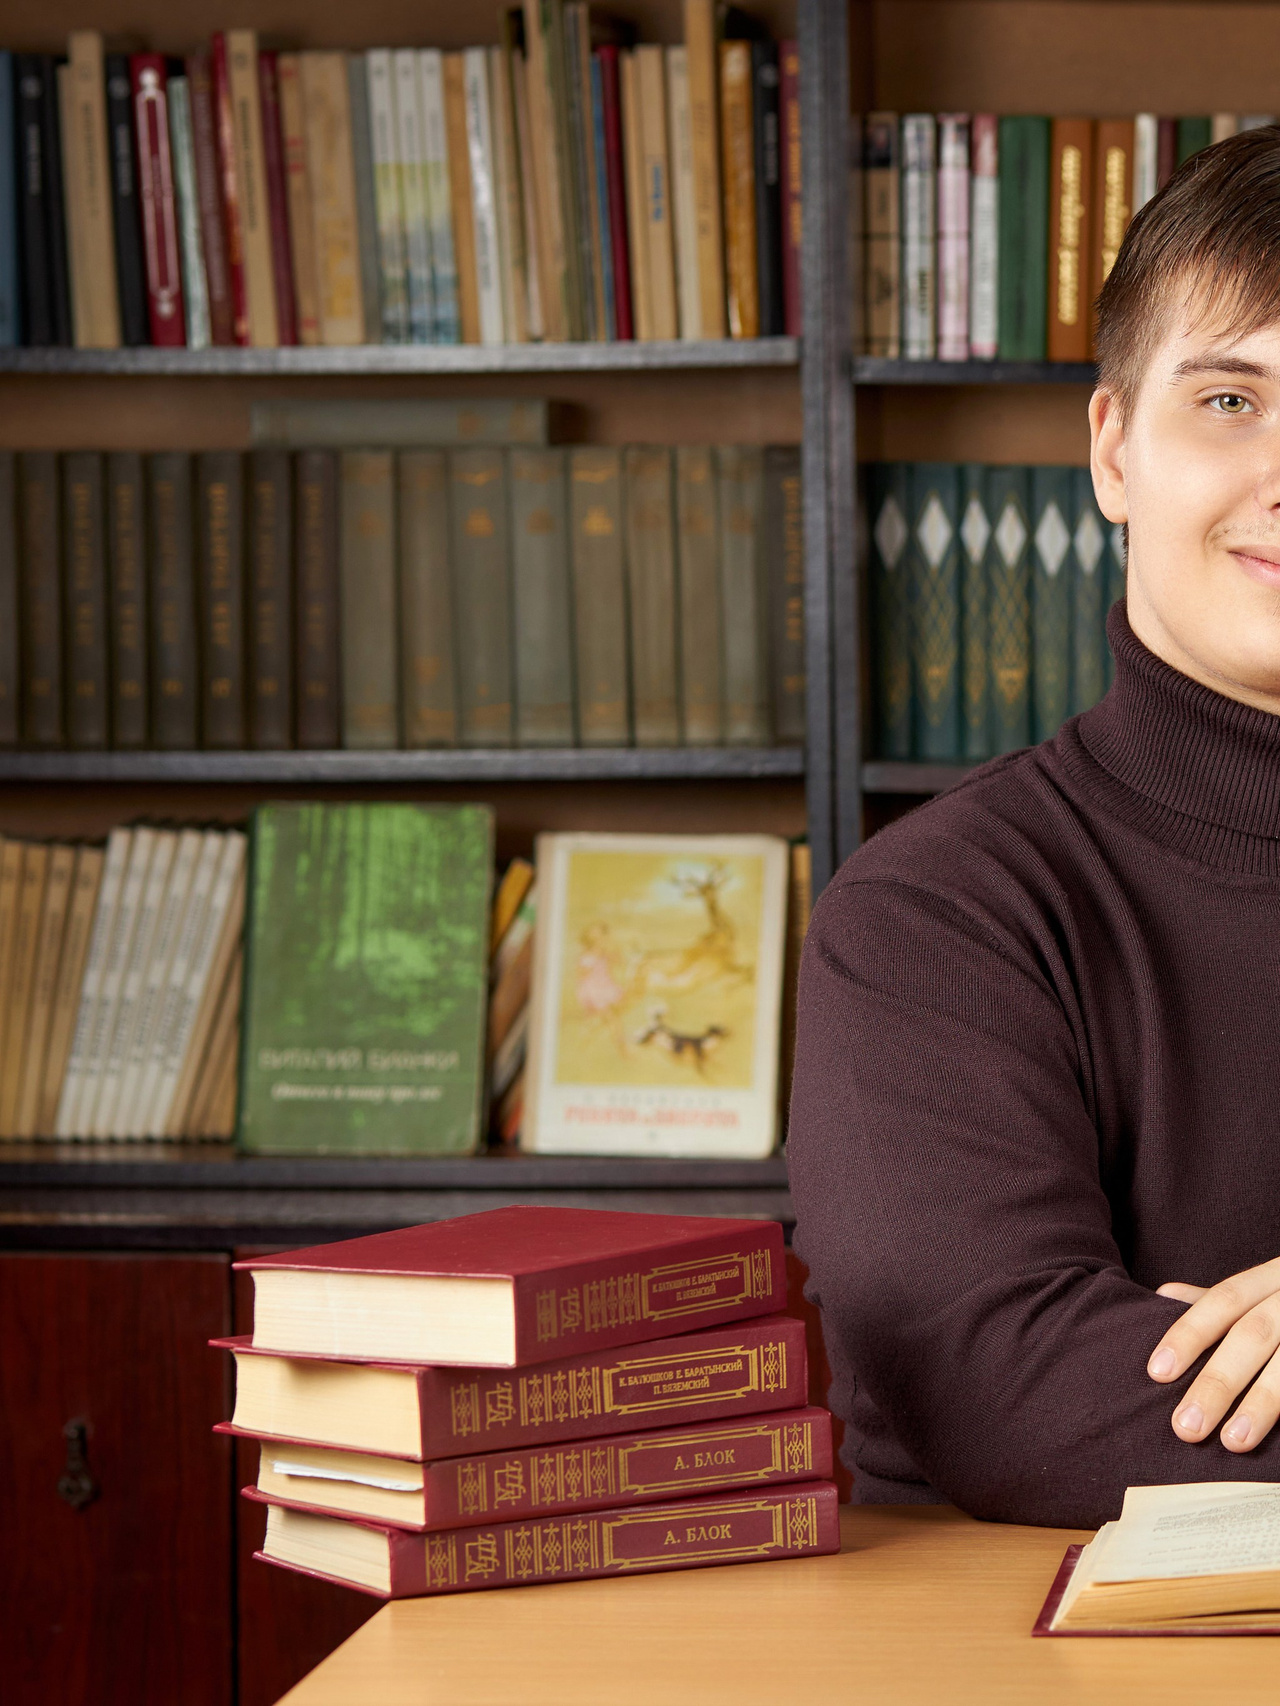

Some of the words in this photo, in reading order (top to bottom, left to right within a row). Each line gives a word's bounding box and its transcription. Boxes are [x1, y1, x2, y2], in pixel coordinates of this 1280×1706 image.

[619, 1376, 629, 1387] К.
[628, 1370, 674, 1385] БАТЮШКОВ
[685, 1358, 743, 1378] БАРАТЫНСКИЙ
[653, 1385, 662, 1395] П.
[663, 1375, 710, 1394] ВЯЗЕМСКИЙ
[674, 1455, 690, 1471] А.
[694, 1449, 736, 1468] БЛОК
[663, 1530, 681, 1545] А.
[686, 1523, 732, 1543] БЛОК
